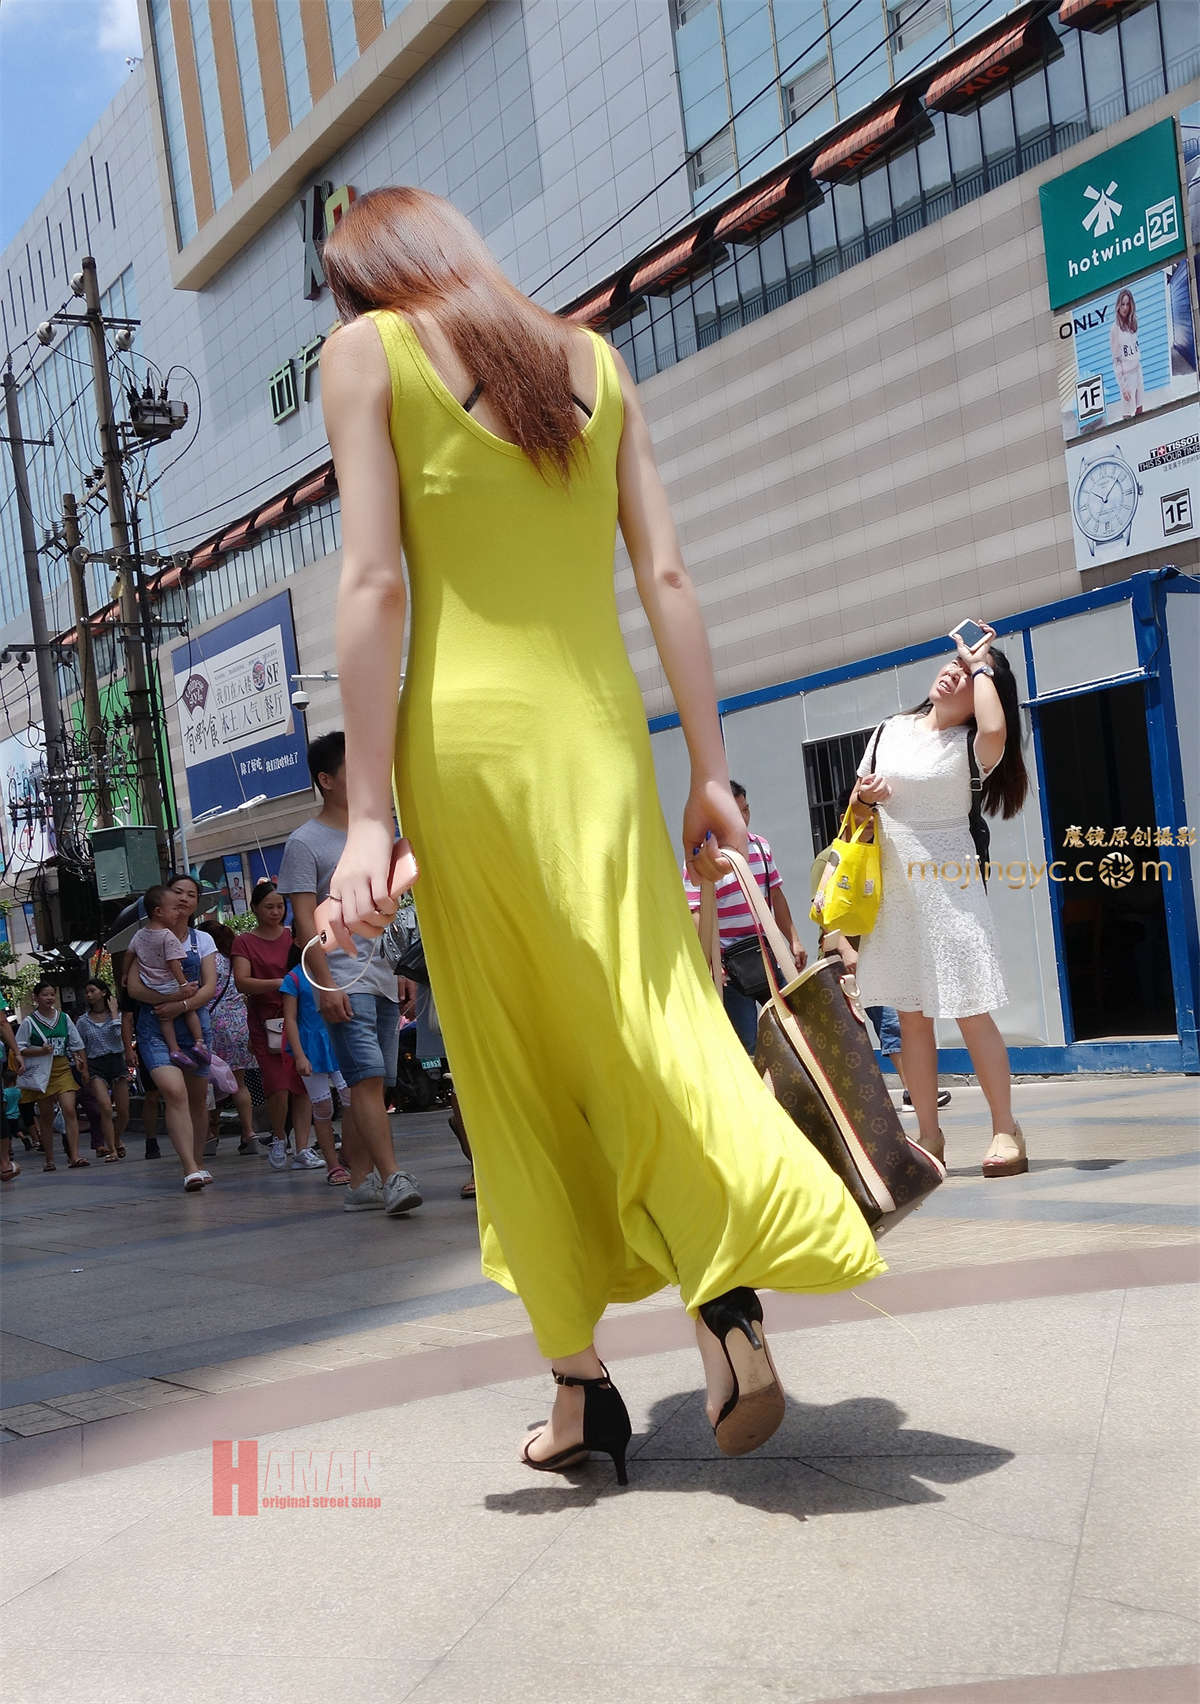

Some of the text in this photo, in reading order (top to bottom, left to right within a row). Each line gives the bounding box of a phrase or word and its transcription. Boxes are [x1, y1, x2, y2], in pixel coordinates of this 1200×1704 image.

[957, 65, 1009, 96] XIG
[1068, 208, 1174, 278] hotwind 2F
[1059, 305, 1108, 340] ONLY
[1079, 386, 1101, 409] 1F
[1167, 434, 1199, 452] TISSOT
[1139, 459, 1154, 471] THIS
[1162, 450, 1183, 463] YOUR
[1165, 500, 1188, 524] 1F
[267, 662, 280, 686] 8F
